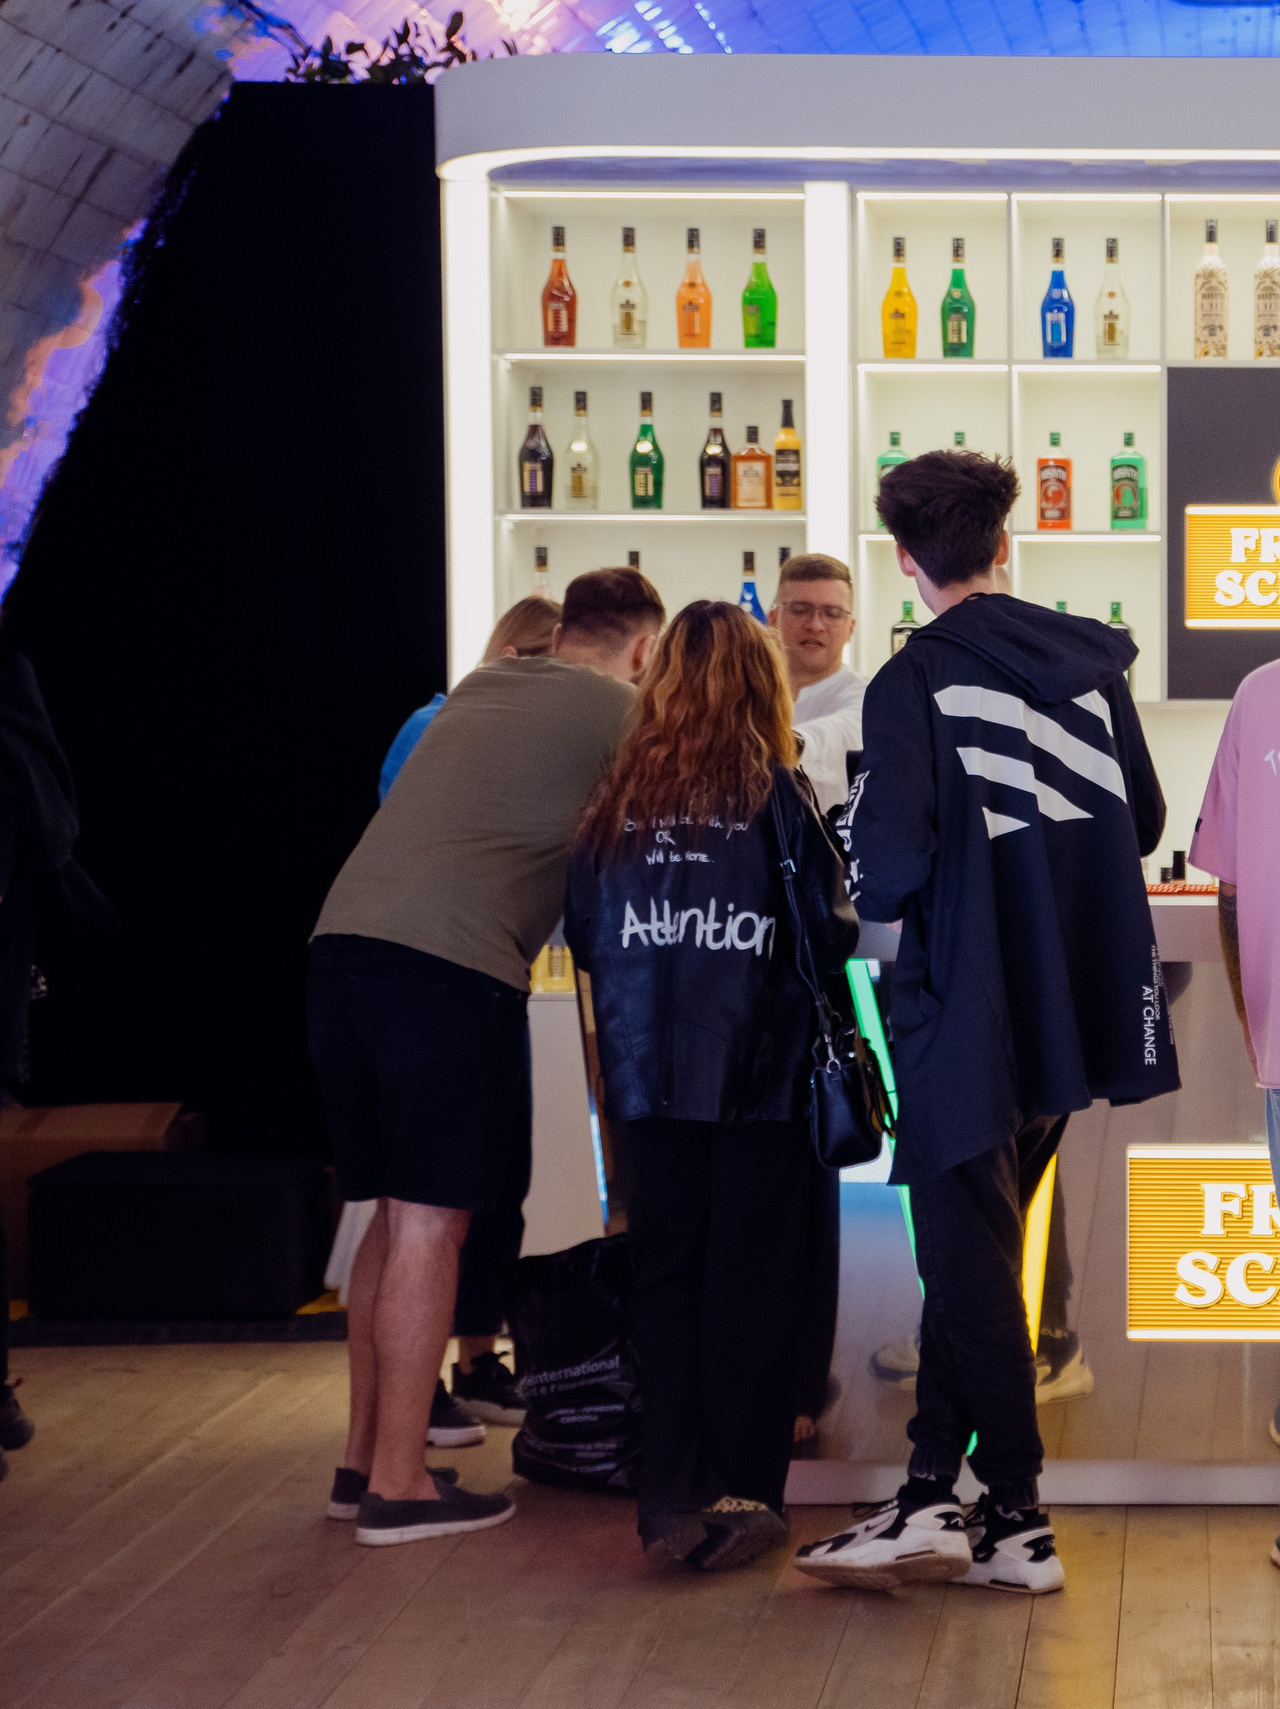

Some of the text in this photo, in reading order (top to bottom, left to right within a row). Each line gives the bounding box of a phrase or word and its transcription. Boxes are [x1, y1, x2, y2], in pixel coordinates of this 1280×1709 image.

[655, 831, 676, 846] OR
[669, 851, 683, 862] be
[619, 897, 776, 961] Attention
[1142, 986, 1157, 1065] AT CHANGE
